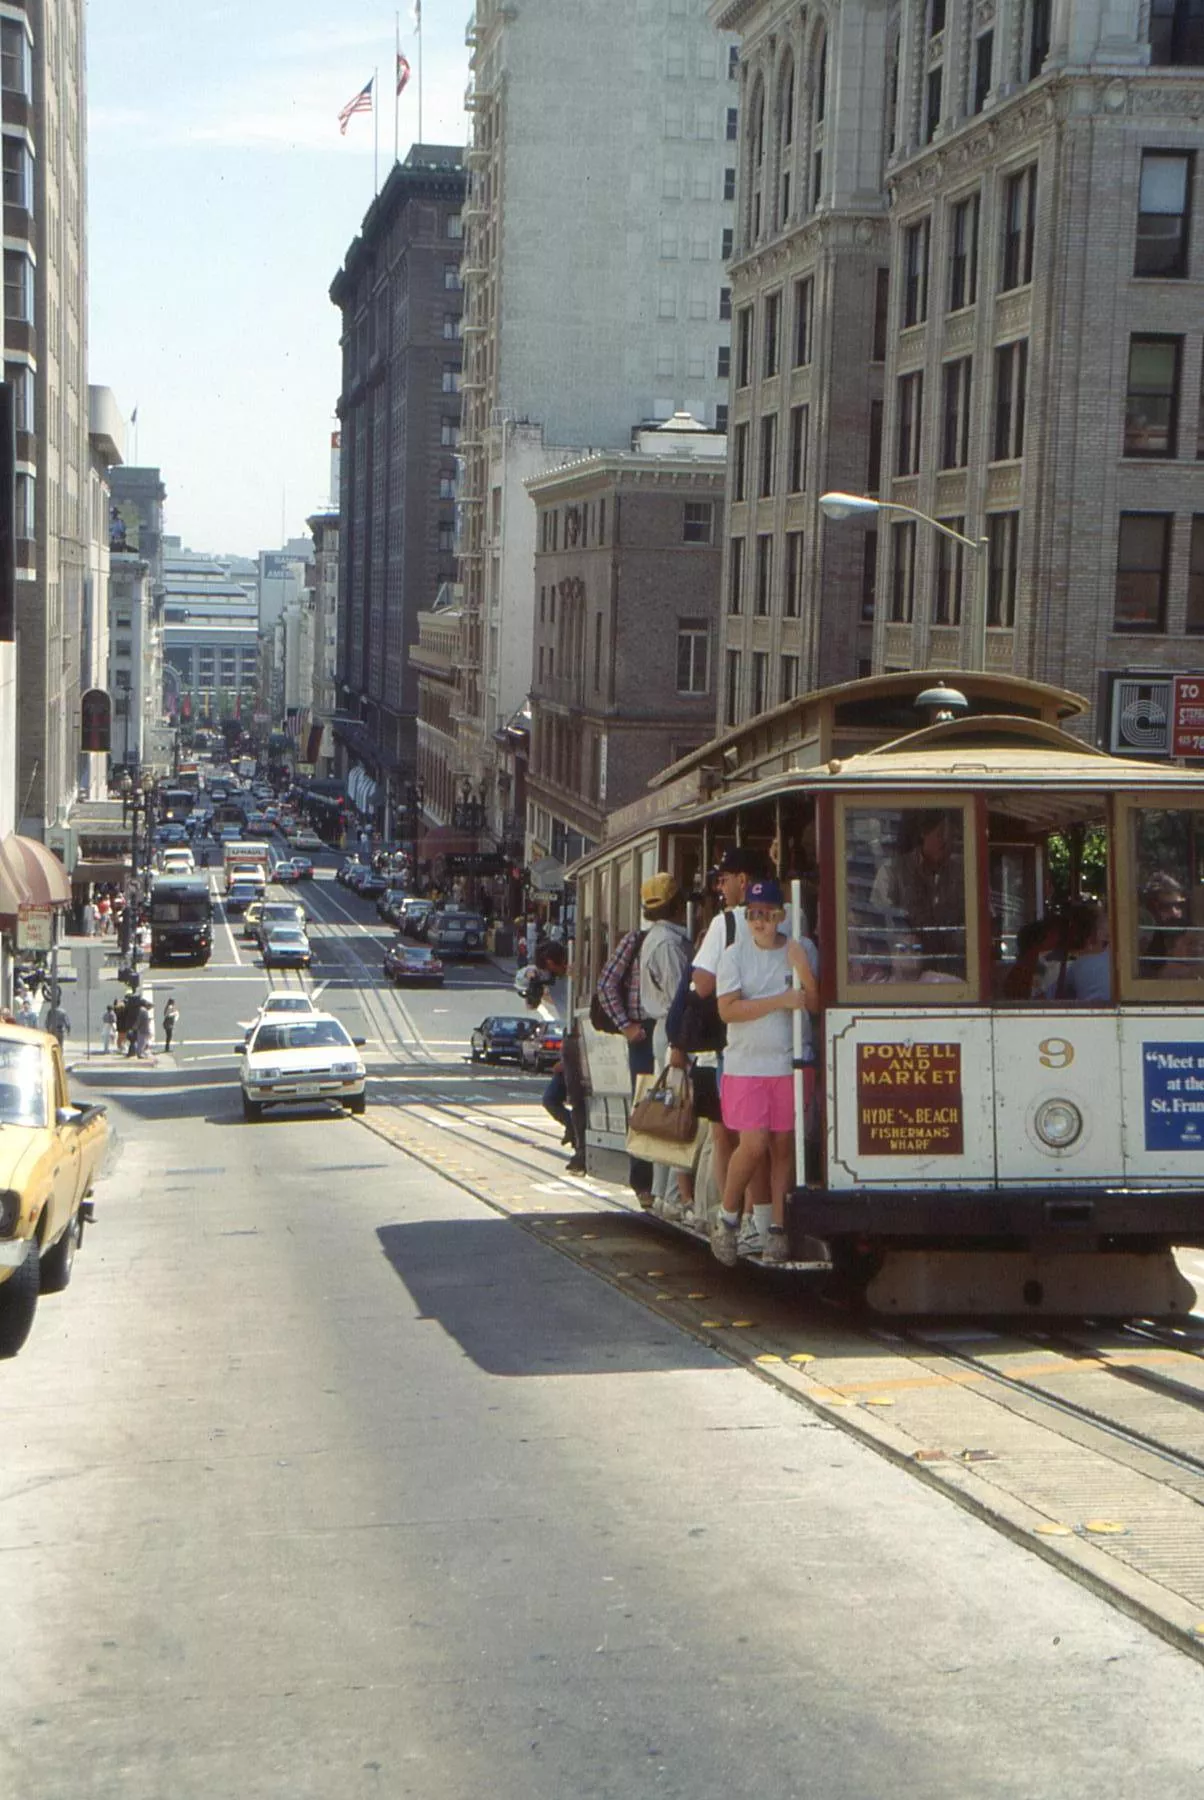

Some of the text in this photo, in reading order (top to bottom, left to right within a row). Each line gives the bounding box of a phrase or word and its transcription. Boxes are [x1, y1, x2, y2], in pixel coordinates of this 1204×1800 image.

[863, 1045, 956, 1059] POWELL
[1038, 1036, 1074, 1069] 9
[888, 1059, 931, 1070] AND
[862, 1070, 957, 1085] MARKET
[1166, 1078, 1181, 1091] at
[1151, 1098, 1171, 1113] St.
[862, 1107, 896, 1124] HYDE
[915, 1107, 958, 1124] BEACH
[870, 1126, 951, 1140] FISHERMANS
[889, 1138, 931, 1151] WHARF
